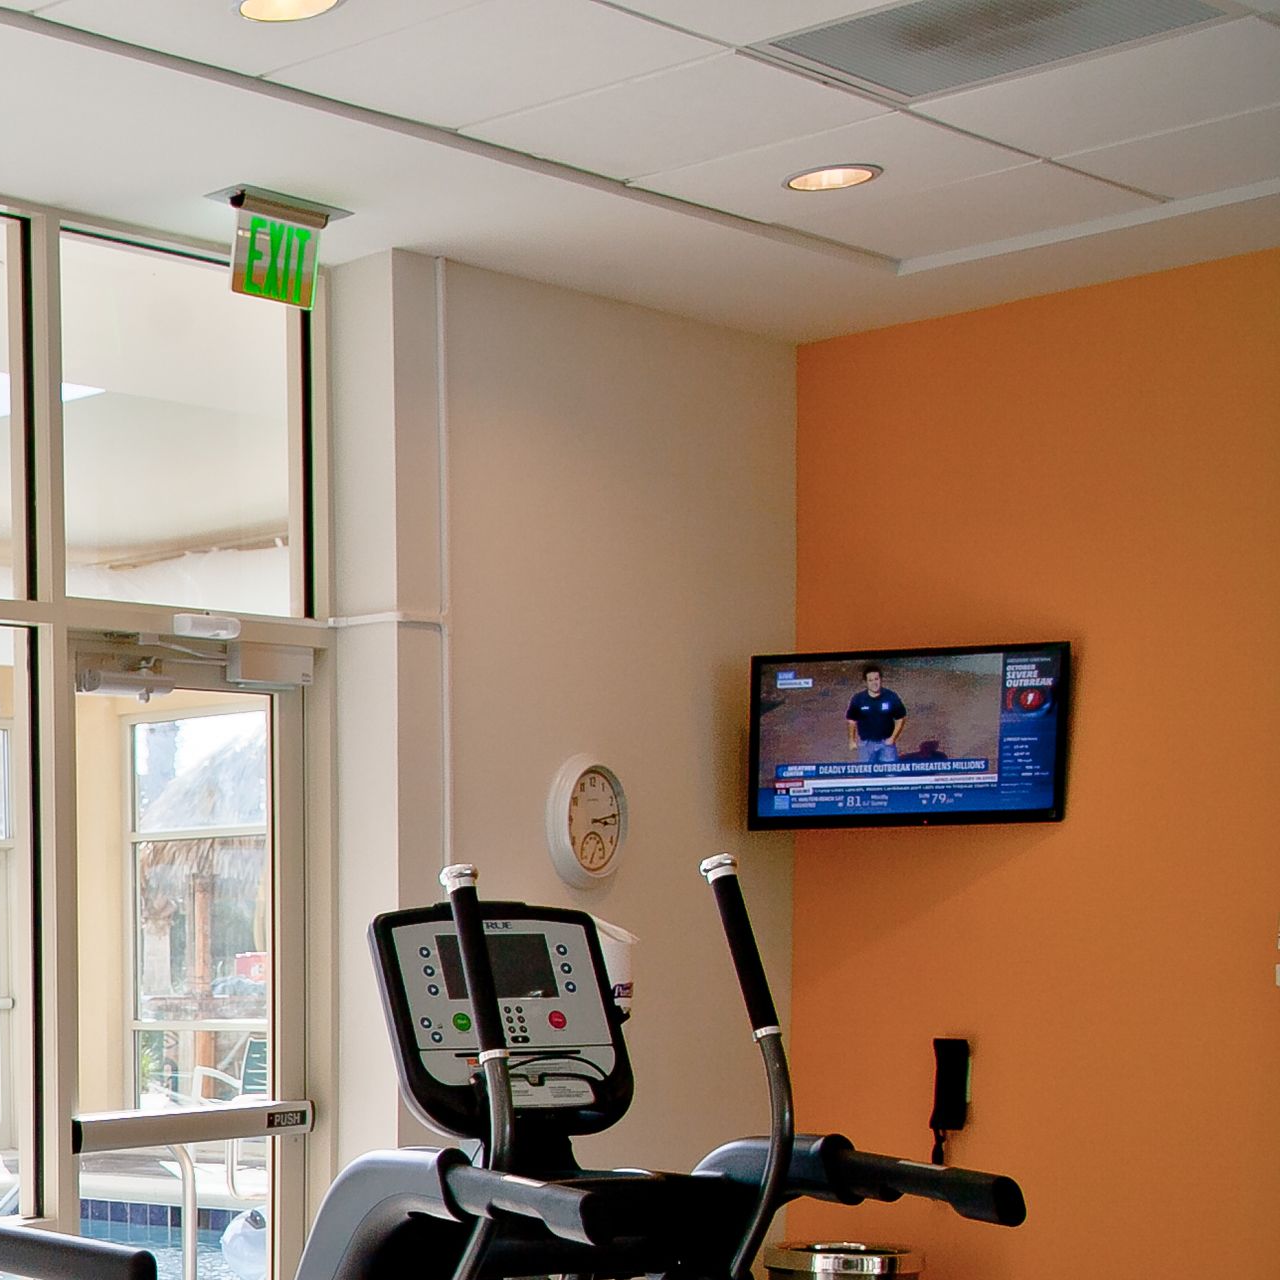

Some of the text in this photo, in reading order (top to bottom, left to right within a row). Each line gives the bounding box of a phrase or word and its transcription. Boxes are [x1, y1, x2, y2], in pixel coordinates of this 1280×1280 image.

[243, 215, 312, 304] EXIT
[1006, 670, 1039, 679] SEVERE
[1006, 677, 1054, 688] OUTBREAK
[819, 760, 985, 775] DEADLY SEVERE OUTBREAK THREATENS MILLIONS
[846, 796, 862, 807] 81
[931, 793, 946, 804] 79
[484, 921, 513, 930] RUE
[274, 1112, 301, 1126] PUSH
